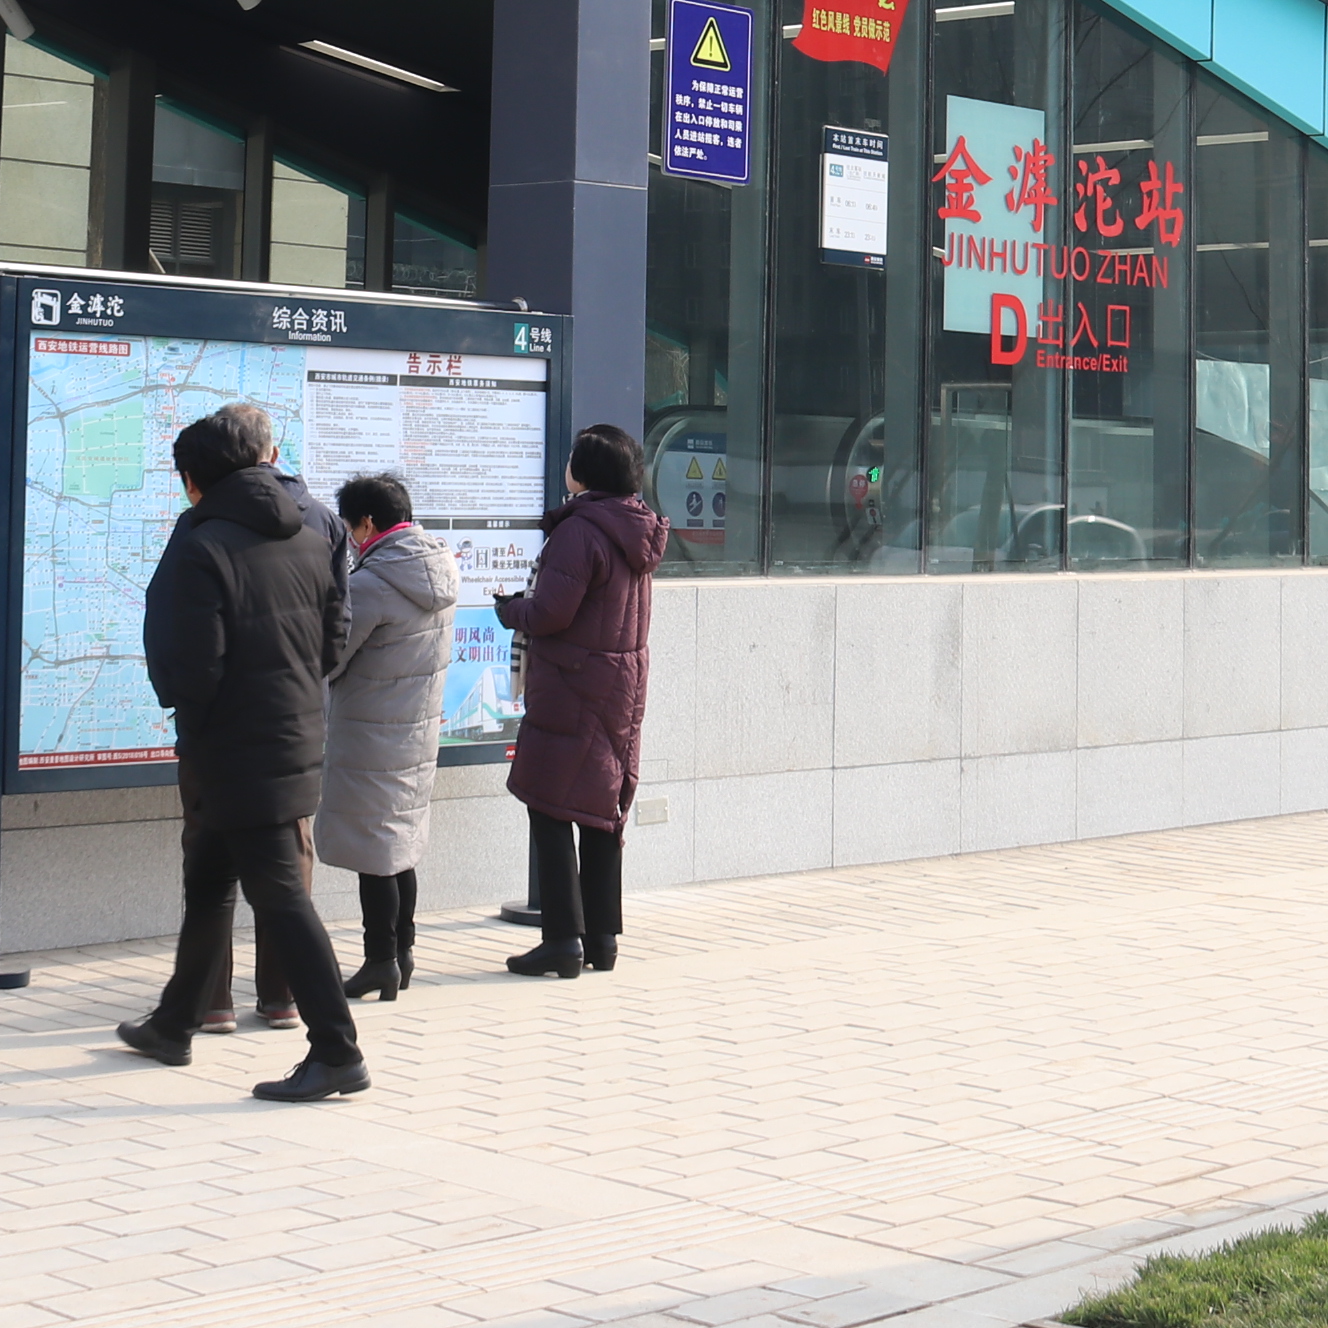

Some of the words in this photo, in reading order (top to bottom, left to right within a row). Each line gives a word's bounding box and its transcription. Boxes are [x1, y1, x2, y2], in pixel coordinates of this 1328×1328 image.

[812, 8, 851, 35] 红色风景线
[853, 15, 891, 42] 党员做示范
[691, 79, 744, 99] 为保障正常运营
[674, 111, 743, 132] 在出入口停放和司乘
[832, 133, 884, 150] 本站首末车时间
[932, 135, 1184, 248] 金滹沱站
[941, 232, 1091, 281] JINHUTUO
[1096, 249, 1169, 289] ZHAN
[66, 292, 125, 318] 金滹沱
[76, 317, 114, 327] JINHUTUO
[272, 306, 348, 333] 综合资讯
[991, 293, 1028, 365] D
[1037, 299, 1131, 349] 出入口
[288, 330, 332, 342] Information
[529, 327, 552, 343] 号线
[37, 339, 129, 355] 西安地铁运营线路图
[529, 343, 545, 353] Line
[546, 344, 552, 353] 4
[407, 353, 463, 376] 告示栏
[1036, 350, 1129, 373] Entrance/Exit
[461, 575, 493, 583] Wheelchair
[494, 575, 525, 583] Accessible
